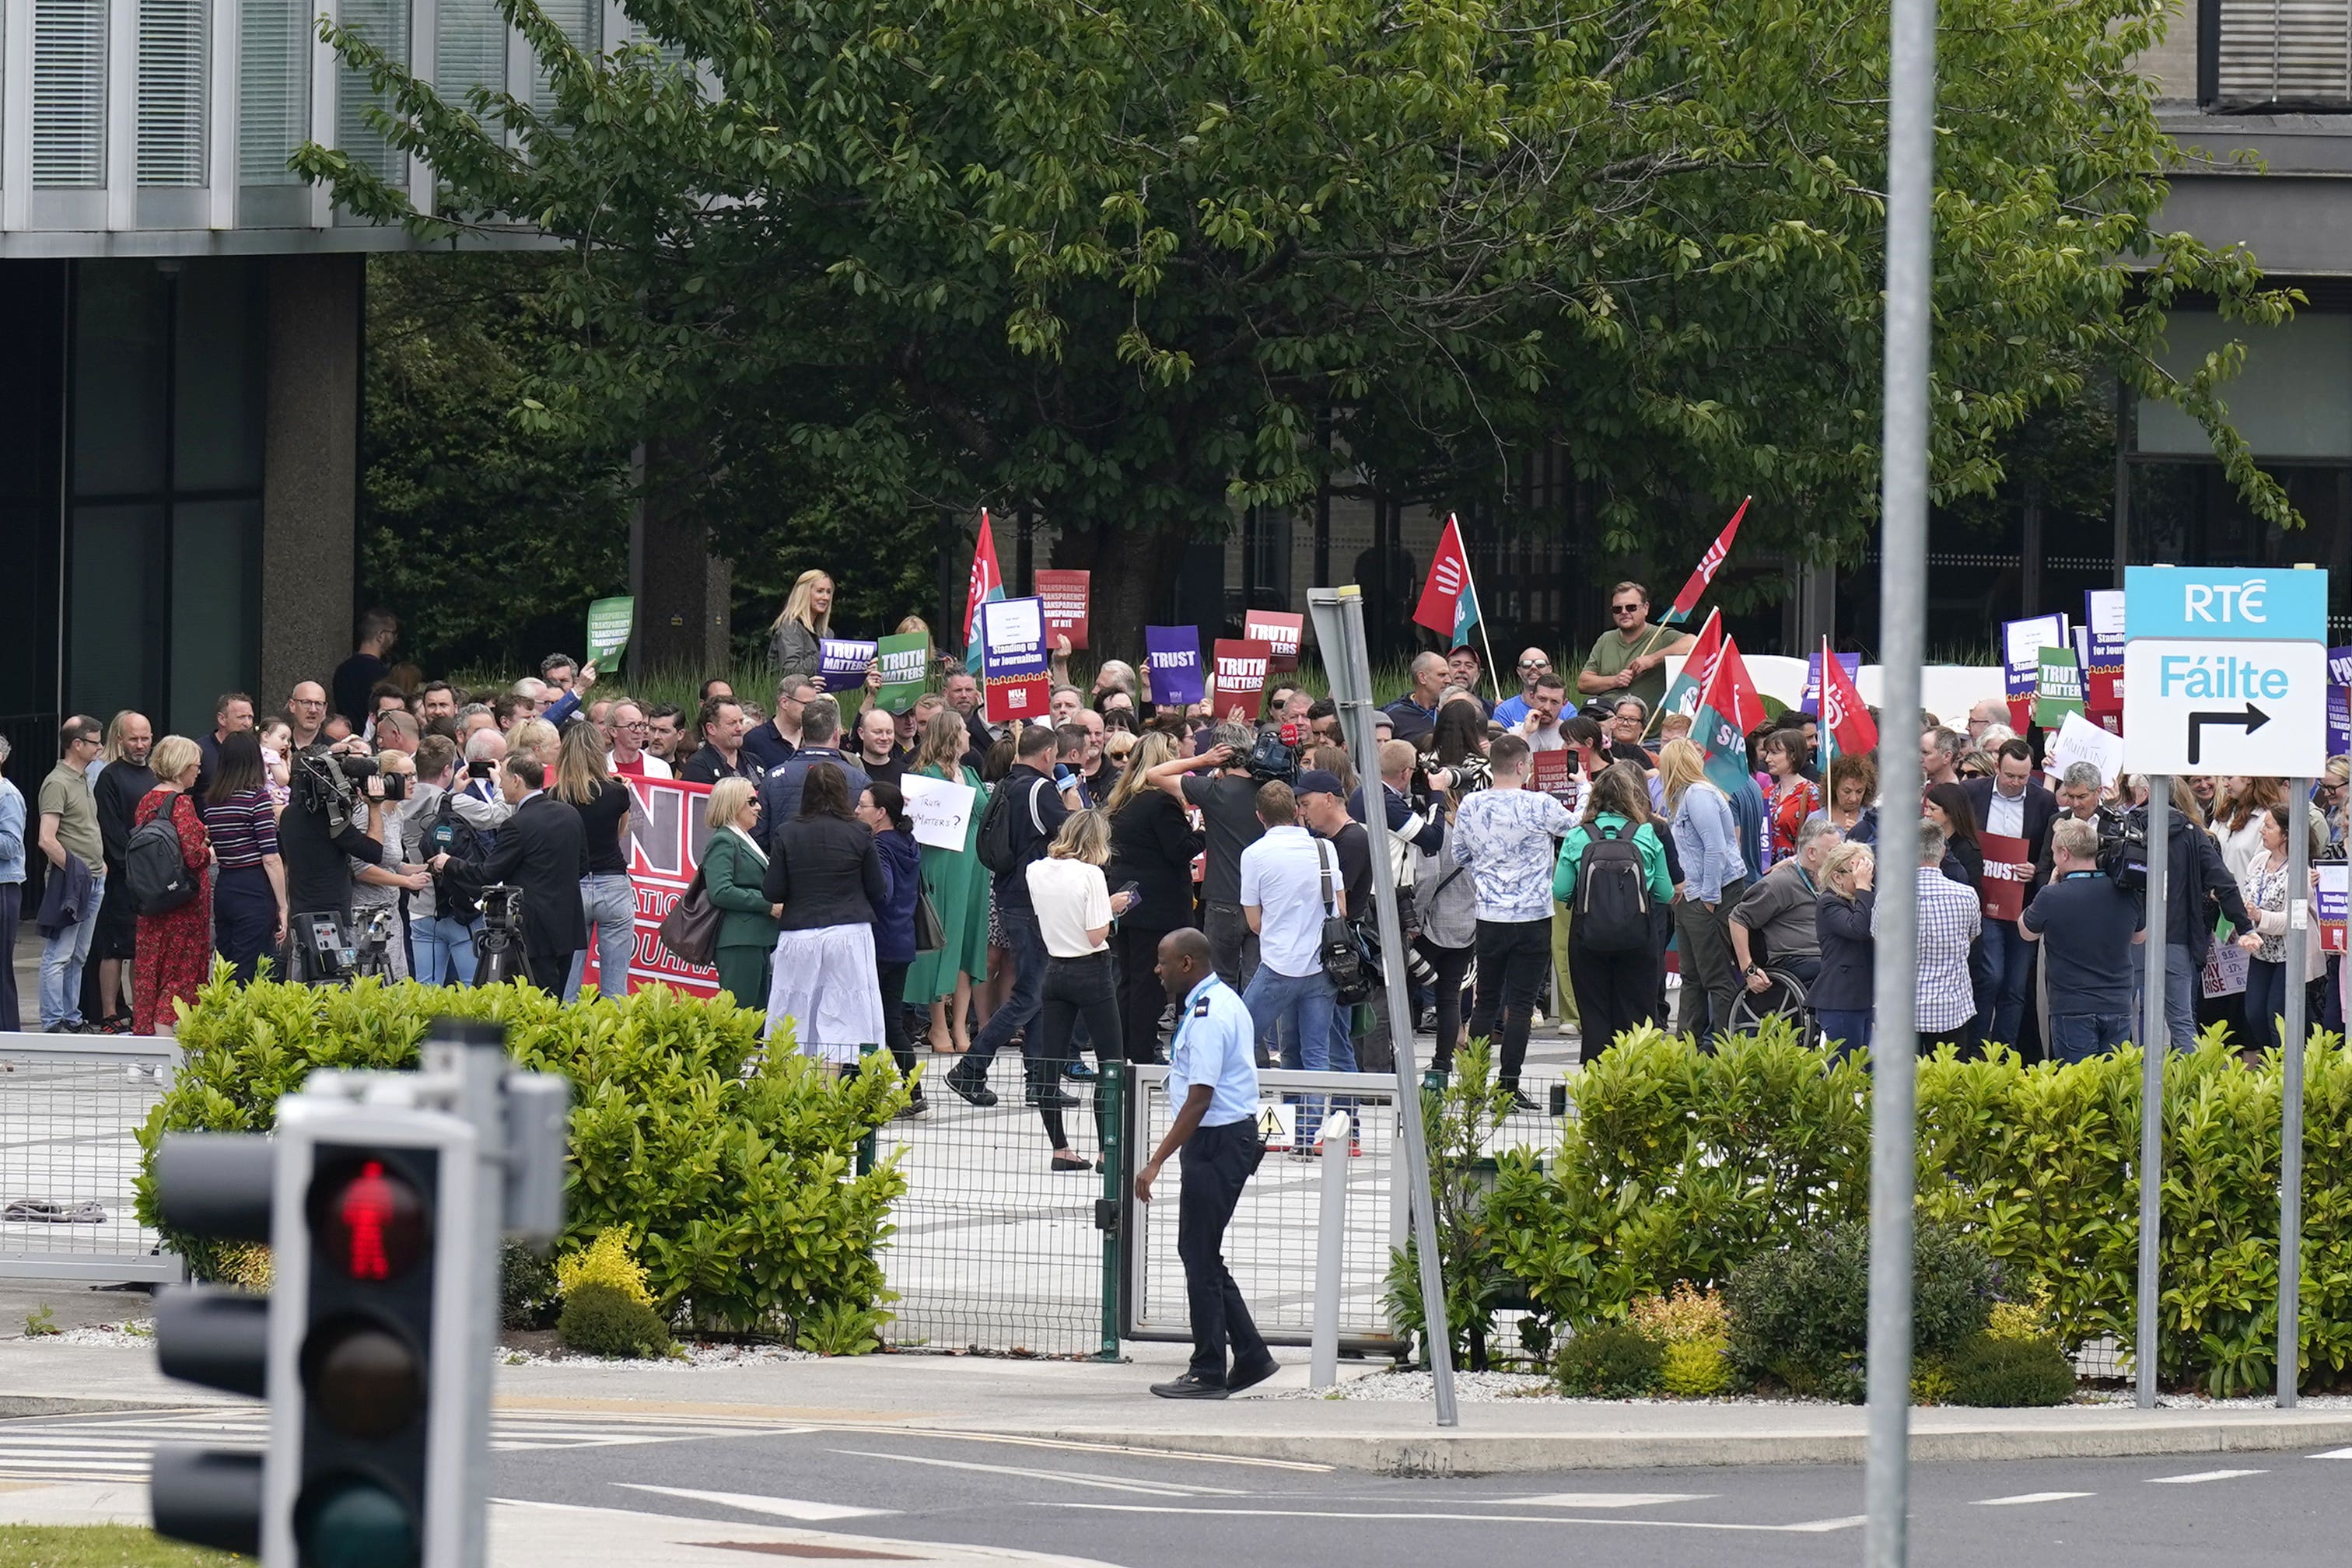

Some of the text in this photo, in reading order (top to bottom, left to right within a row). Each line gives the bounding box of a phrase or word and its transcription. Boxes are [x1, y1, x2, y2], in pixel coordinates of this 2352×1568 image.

[1043, 601, 1086, 610] RANSPARENCY
[2185, 579, 2266, 623] RTÉ
[1044, 610, 1086, 618] RANSPARENCY
[1249, 623, 1299, 642] TRUTH
[824, 642, 875, 660] TRUTH
[992, 642, 1038, 655] Standing up
[1271, 642, 1297, 655] TERS
[822, 656, 870, 671] MATTERS
[881, 649, 926, 671] TRUTH
[989, 653, 1042, 667] for Journalism
[1151, 651, 1195, 669] TRUST
[1217, 657, 1267, 677] TRUTH
[881, 665, 925, 682] MATTERS
[2009, 674, 2021, 684] for
[2042, 664, 2081, 684] TRUT
[2161, 656, 2289, 699] Fáilte
[1216, 676, 1265, 689] MATTERS
[2041, 683, 2082, 697] MATTER
[2112, 679, 2124, 688] NU
[1008, 688, 1027, 698] NUJ
[2204, 978, 2226, 994] RISE
